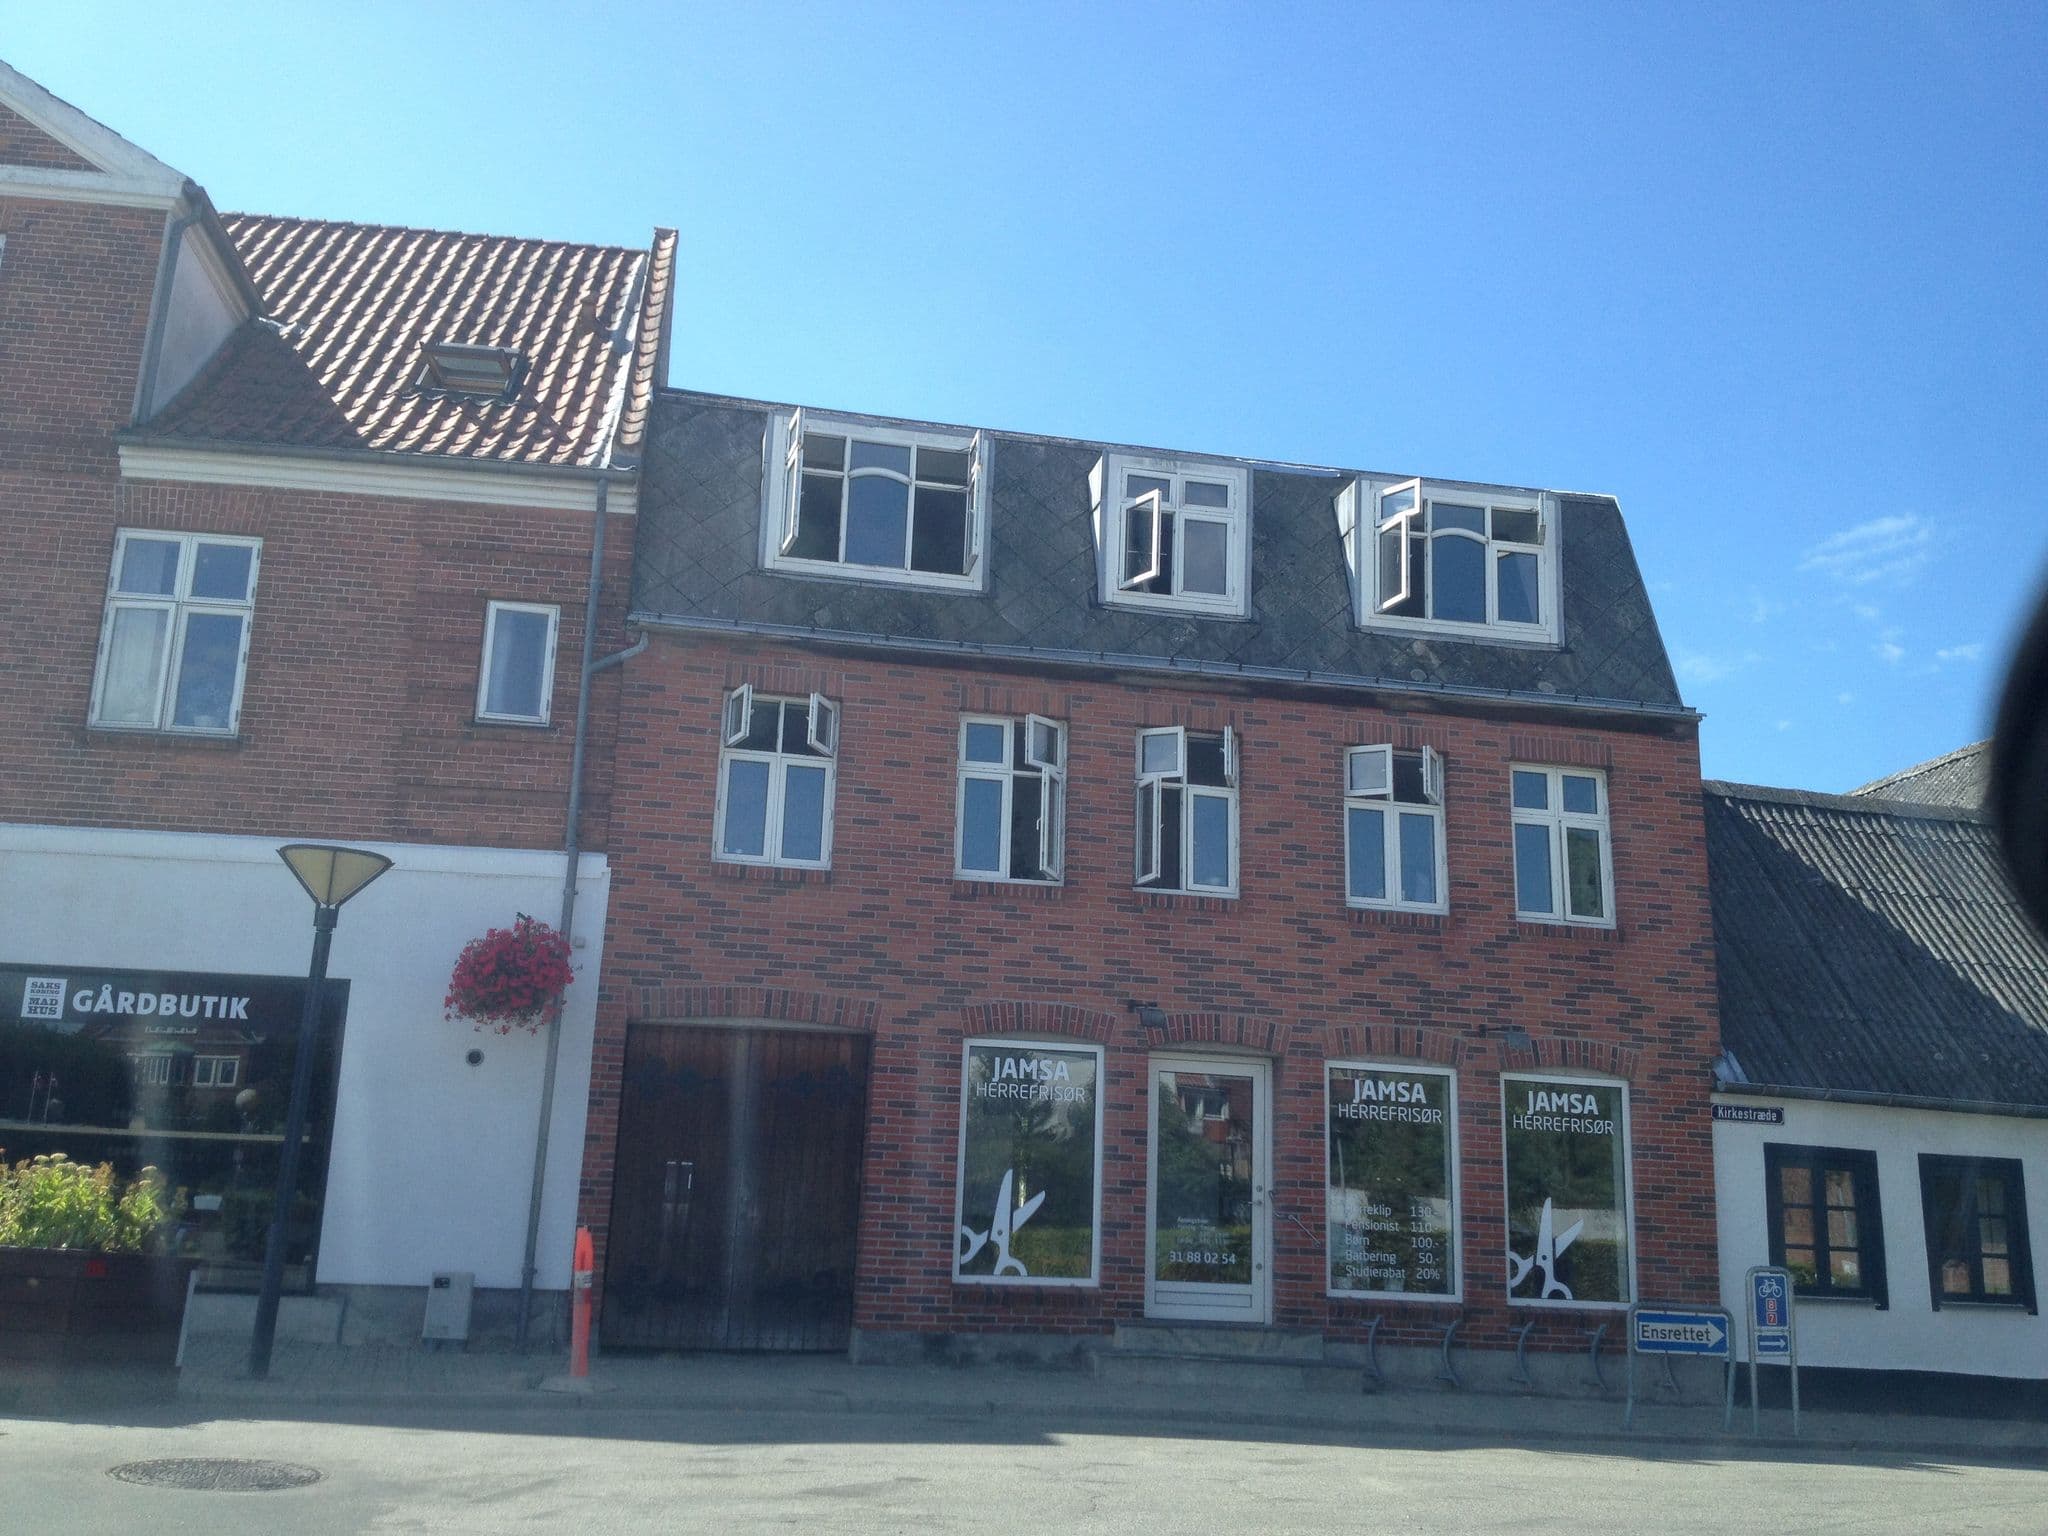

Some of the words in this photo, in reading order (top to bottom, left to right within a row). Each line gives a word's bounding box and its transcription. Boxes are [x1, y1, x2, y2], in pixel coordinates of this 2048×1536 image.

[31, 981, 61, 990] SAKS
[27, 1005, 58, 1016] HUS
[29, 997, 59, 1006] MAD
[72, 984, 250, 1020] GÅRDBUTIK
[992, 1056, 1070, 1082] JAMSA
[976, 1081, 1086, 1103] HERREFRISØR
[1353, 1079, 1427, 1104] JAMSA
[1527, 1090, 1599, 1115] JAMSA
[1338, 1103, 1443, 1124] HERREFRISØR
[1718, 1106, 1777, 1121] Kirkestræde
[1513, 1114, 1615, 1135] HERREFRISØR
[1345, 1204, 1392, 1217] rreklip
[1169, 1251, 1183, 1263] 31
[1187, 1251, 1201, 1263] 88
[1204, 1252, 1218, 1265] 02
[1222, 1253, 1236, 1265] 54
[1345, 1264, 1406, 1279] Studierabat
[1416, 1268, 1441, 1280] 20%
[1640, 1324, 1712, 1342] Ensrettet
